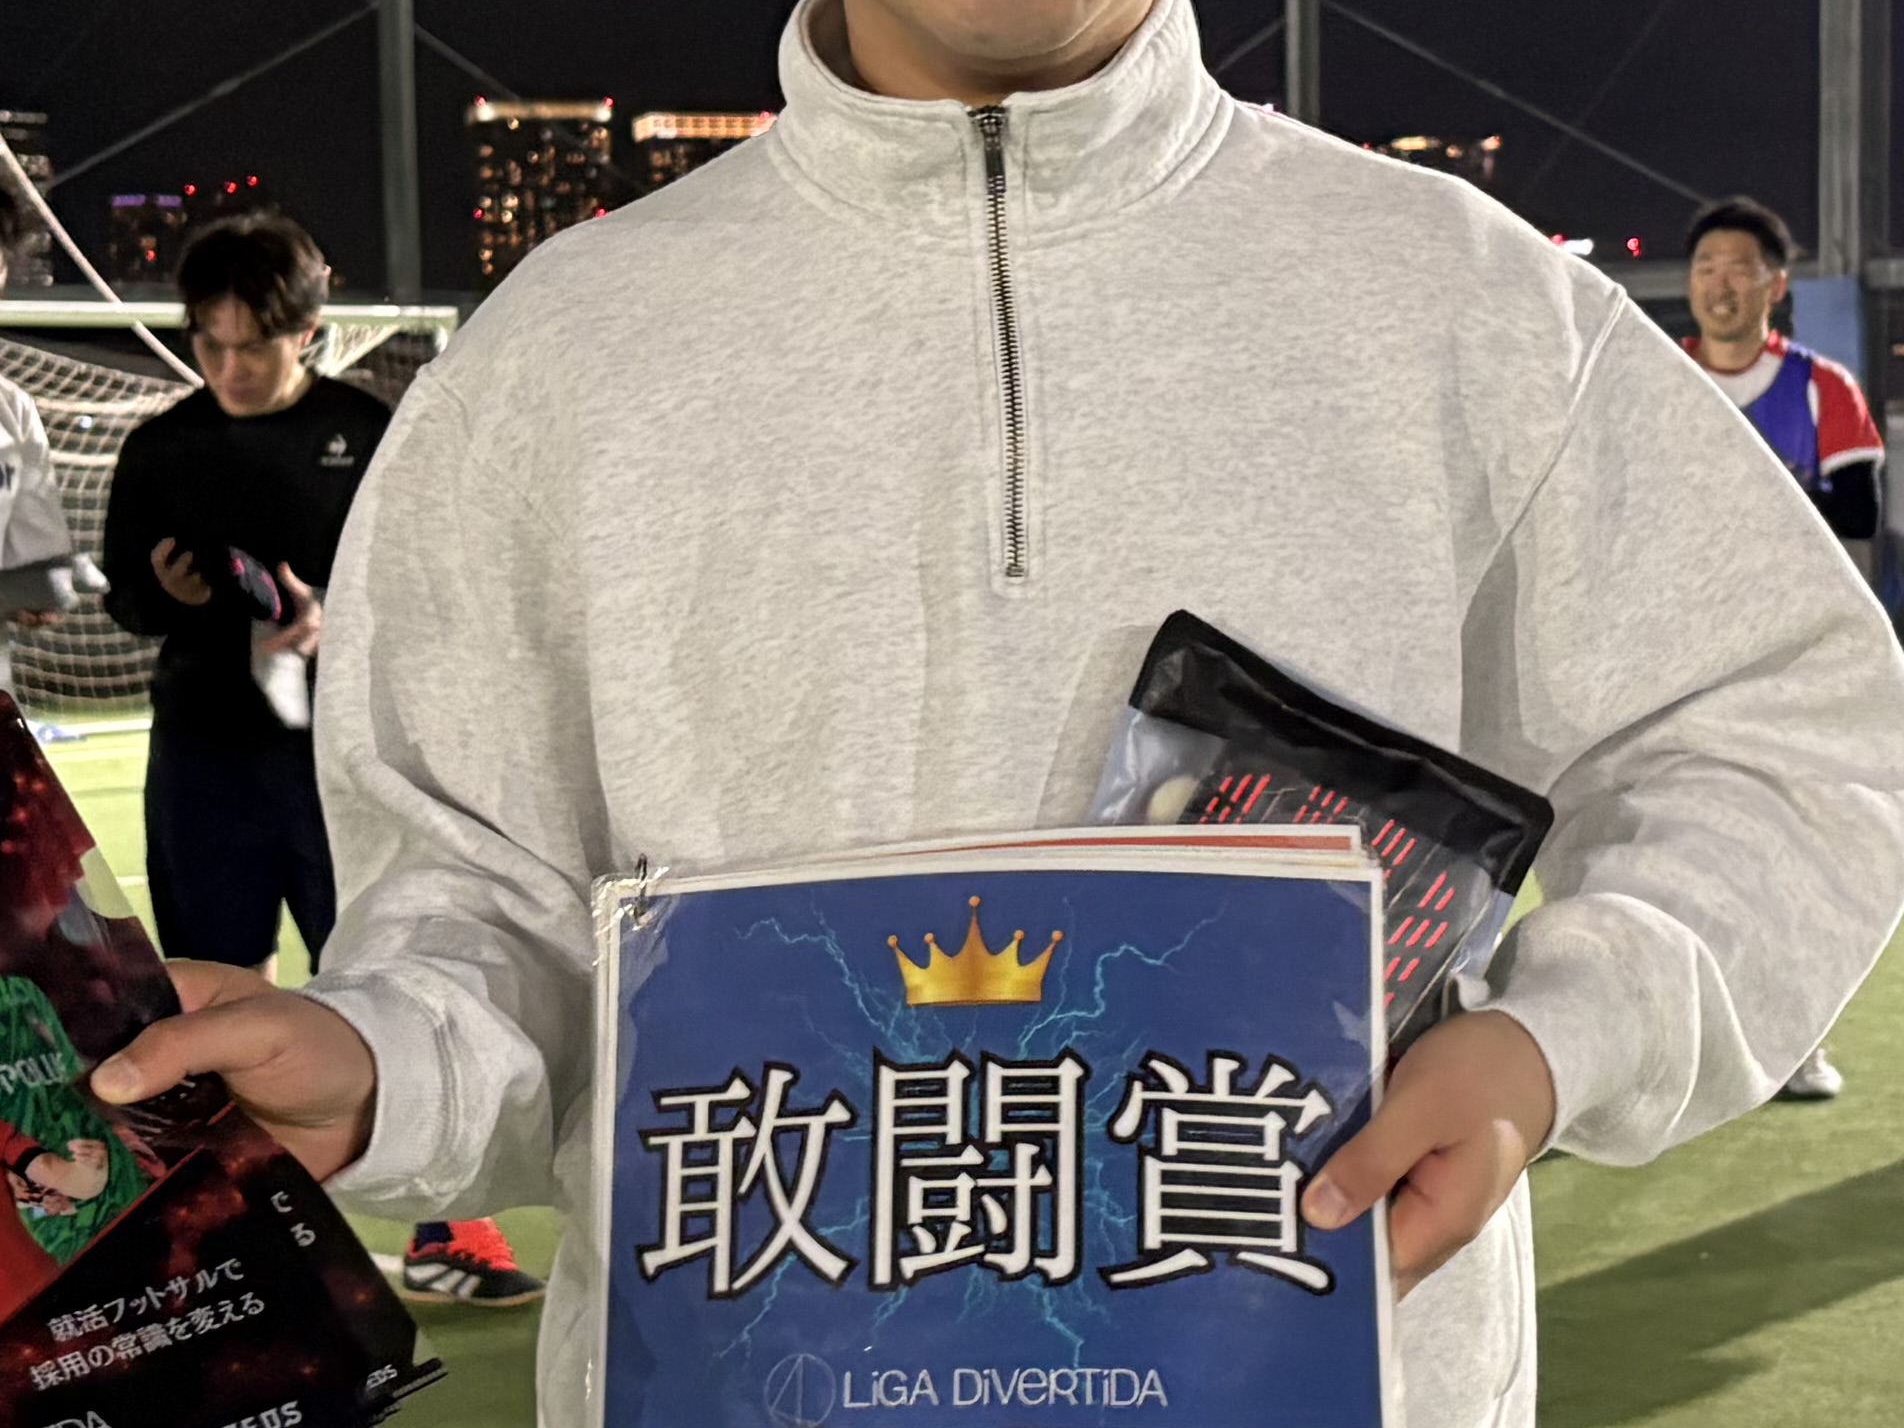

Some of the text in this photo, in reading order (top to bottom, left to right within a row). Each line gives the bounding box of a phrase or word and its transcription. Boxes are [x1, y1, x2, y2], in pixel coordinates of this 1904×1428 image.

[637, 1052, 1336, 1297] 敢闘賞
[30, 1291, 266, 1391] 採用の常識を変える
[49, 1257, 245, 1342] 就活フットサルで
